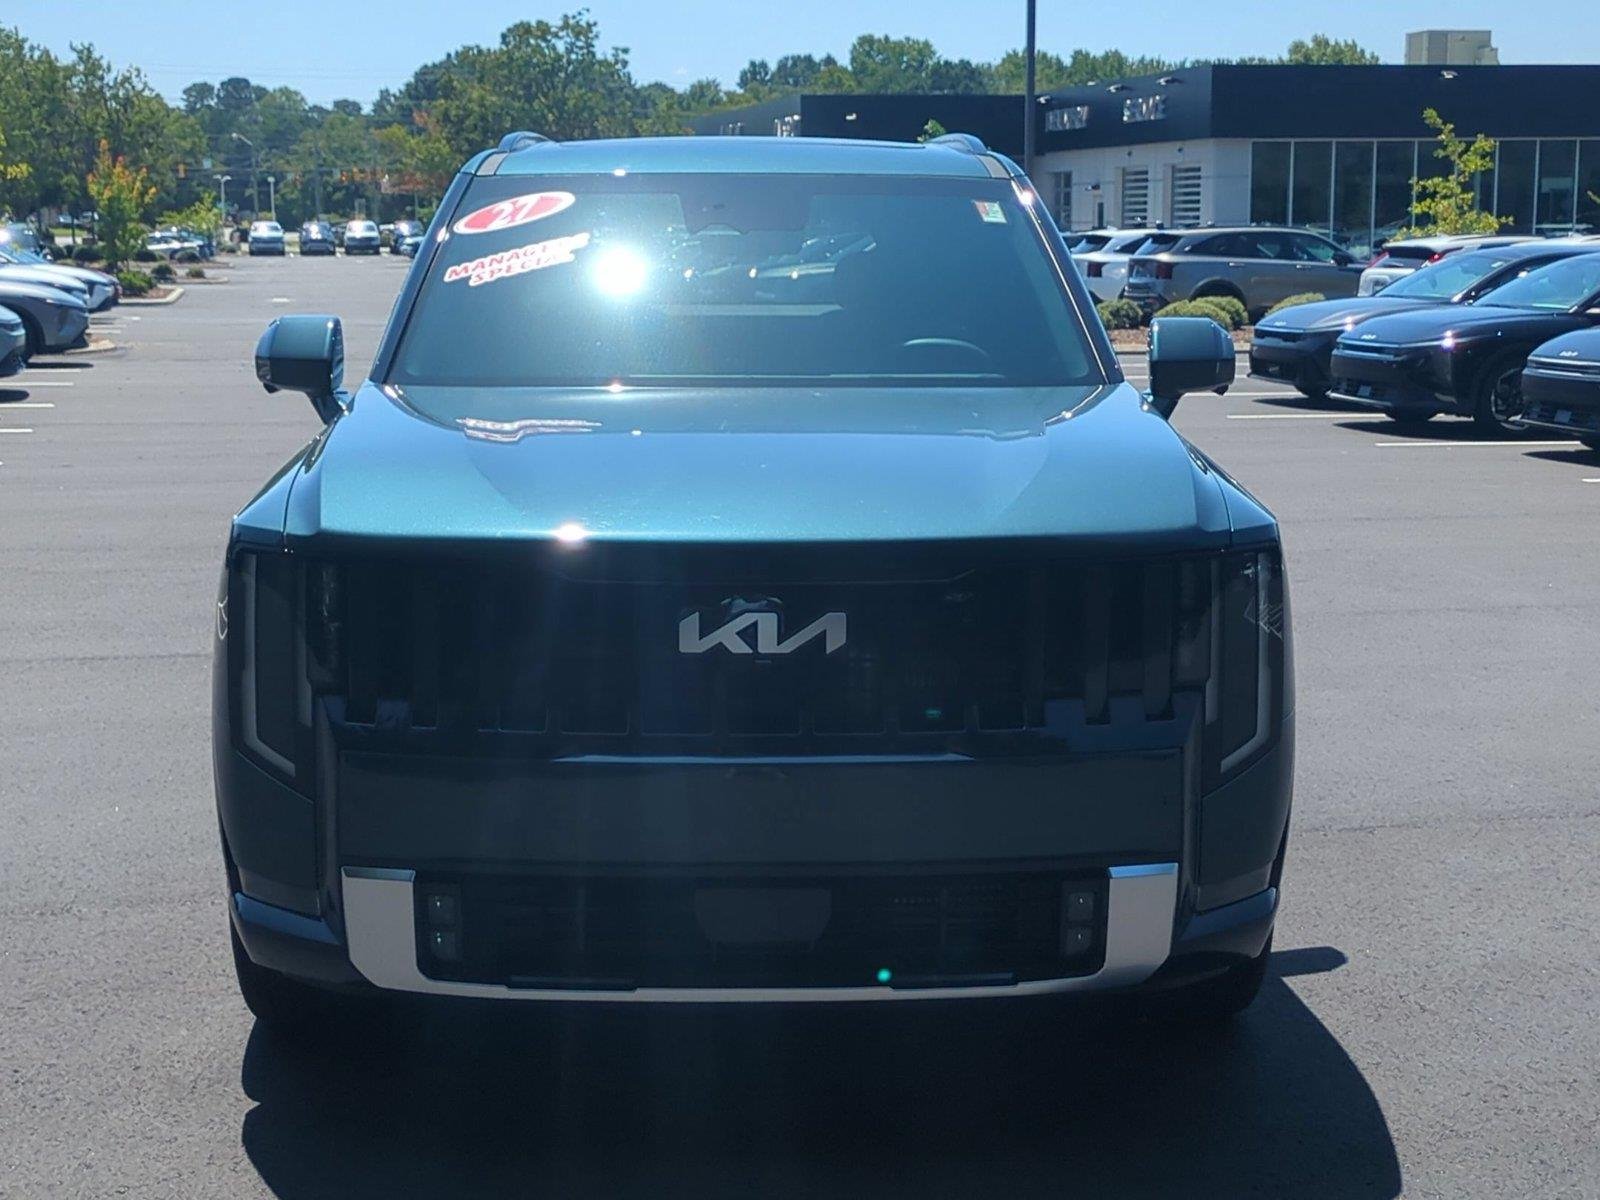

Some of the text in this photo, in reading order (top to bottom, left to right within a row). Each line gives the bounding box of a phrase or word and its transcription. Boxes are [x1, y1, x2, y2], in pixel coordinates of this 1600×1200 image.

[486, 195, 540, 228] 27
[474, 252, 572, 284] SPECIA
[679, 612, 847, 654] KIA
